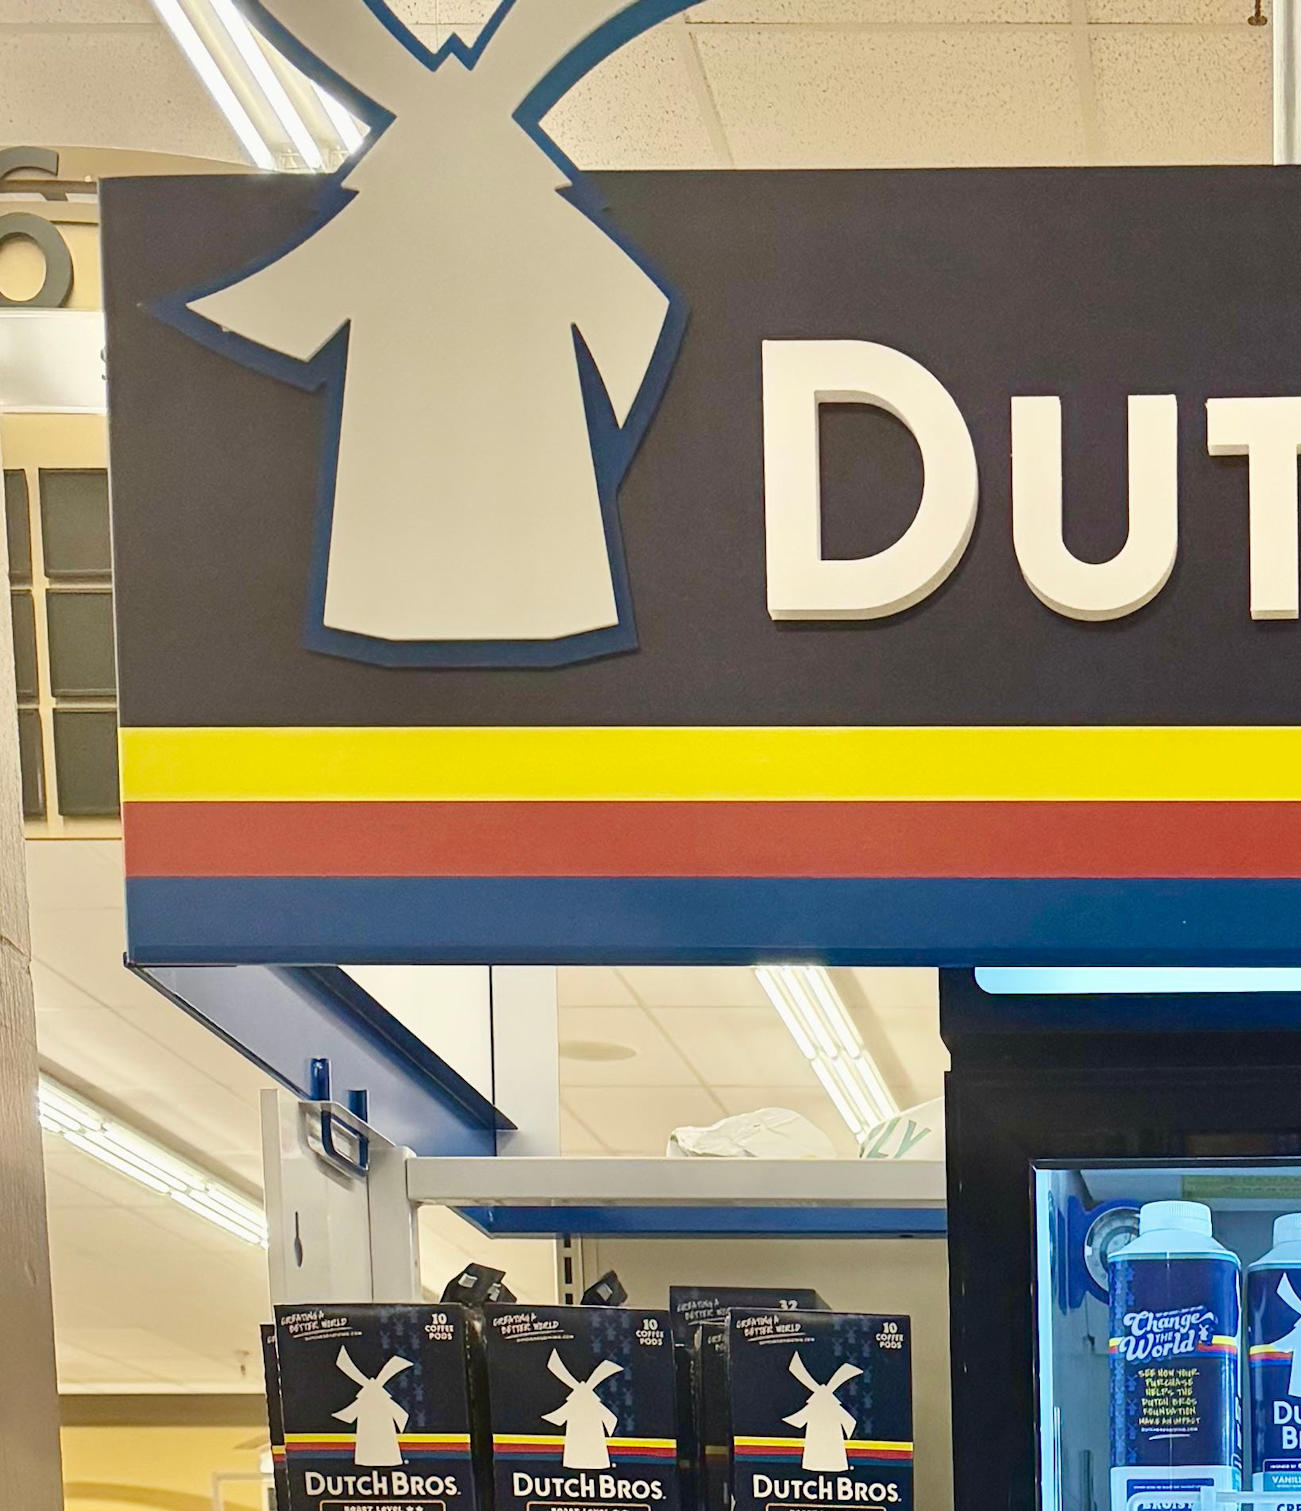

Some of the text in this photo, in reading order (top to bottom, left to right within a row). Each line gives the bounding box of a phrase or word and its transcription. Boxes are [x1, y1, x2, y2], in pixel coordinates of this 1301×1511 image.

[1123, 1311, 1214, 1336] Change
[1119, 1330, 1196, 1361] World
[1156, 1333, 1173, 1343] THE
